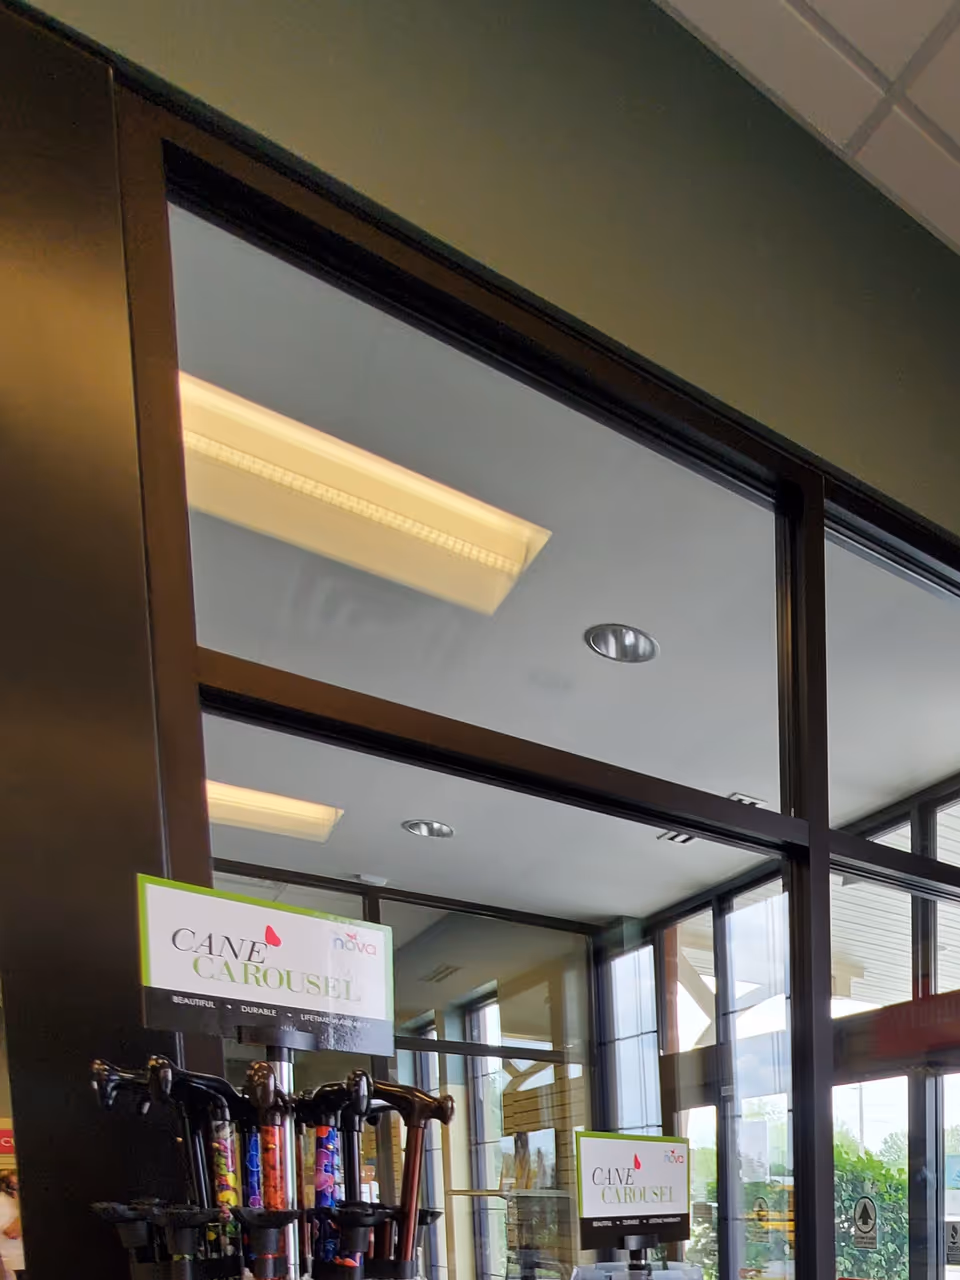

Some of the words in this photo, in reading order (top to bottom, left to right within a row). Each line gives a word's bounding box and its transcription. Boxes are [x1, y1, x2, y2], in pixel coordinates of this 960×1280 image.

[171, 927, 268, 965] CANE
[332, 934, 378, 957] nova
[192, 956, 362, 1003] CAROUSEL
[172, 996, 216, 1009] BEAUTIFUL
[241, 1005, 277, 1017] DURABLE
[592, 1166, 635, 1186] CANE
[601, 1186, 674, 1204] CAROUSEL
